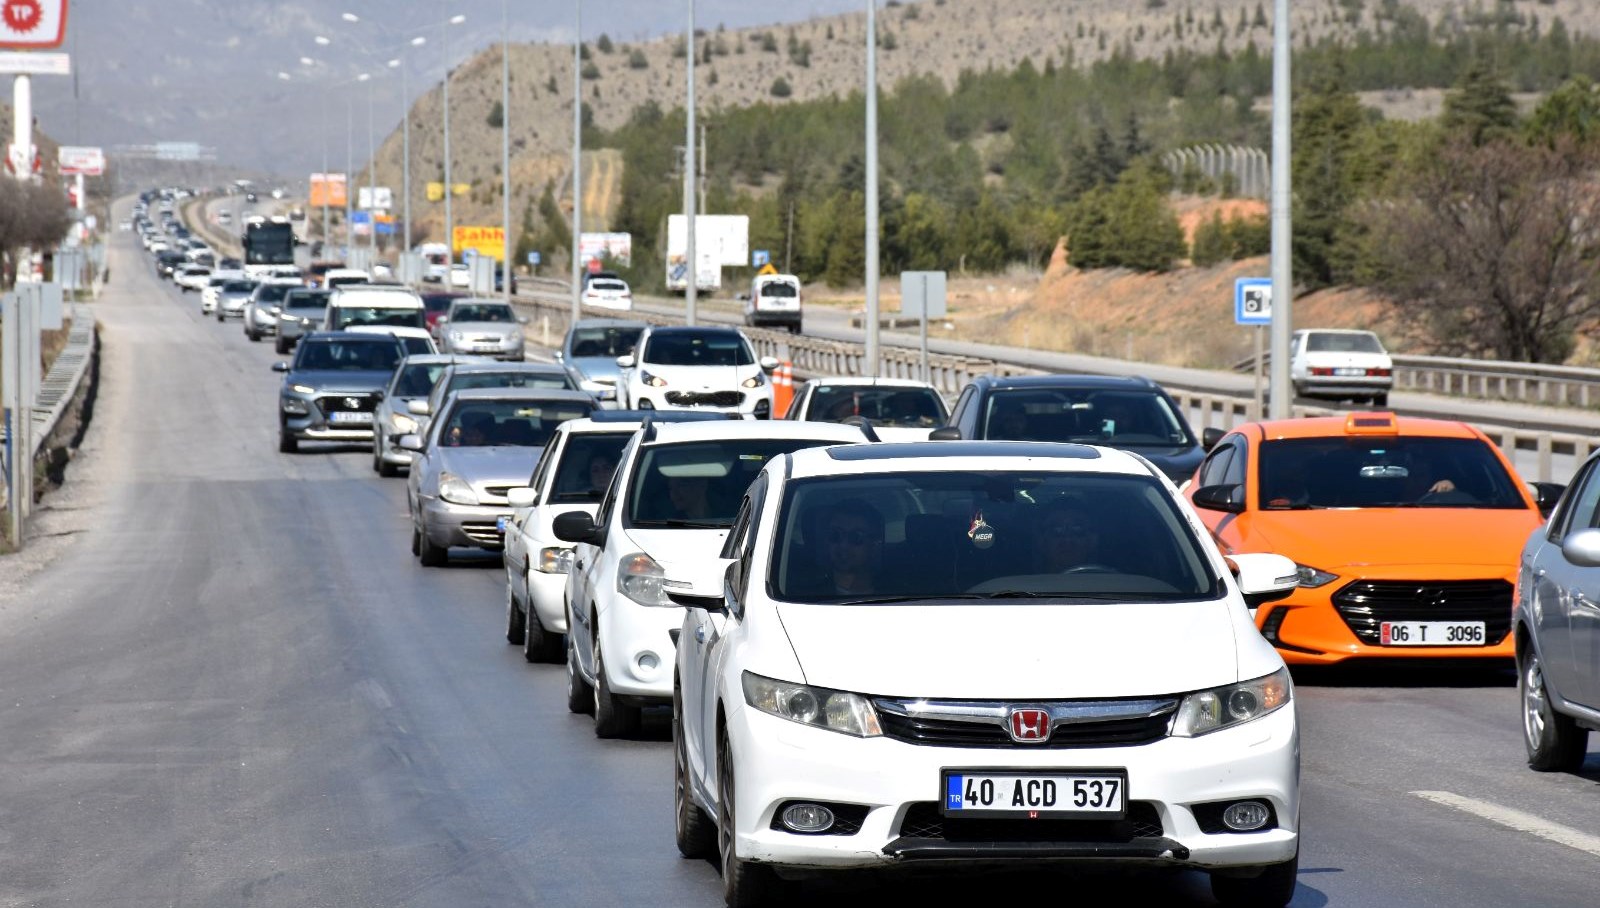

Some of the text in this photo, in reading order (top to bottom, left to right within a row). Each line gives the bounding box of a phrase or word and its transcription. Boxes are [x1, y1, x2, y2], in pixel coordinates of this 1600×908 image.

[11, 4, 34, 21] TP
[1391, 625, 1482, 641] 06 T 3096
[950, 794, 961, 803] TR
[964, 778, 1119, 808] 40 ACD 537
